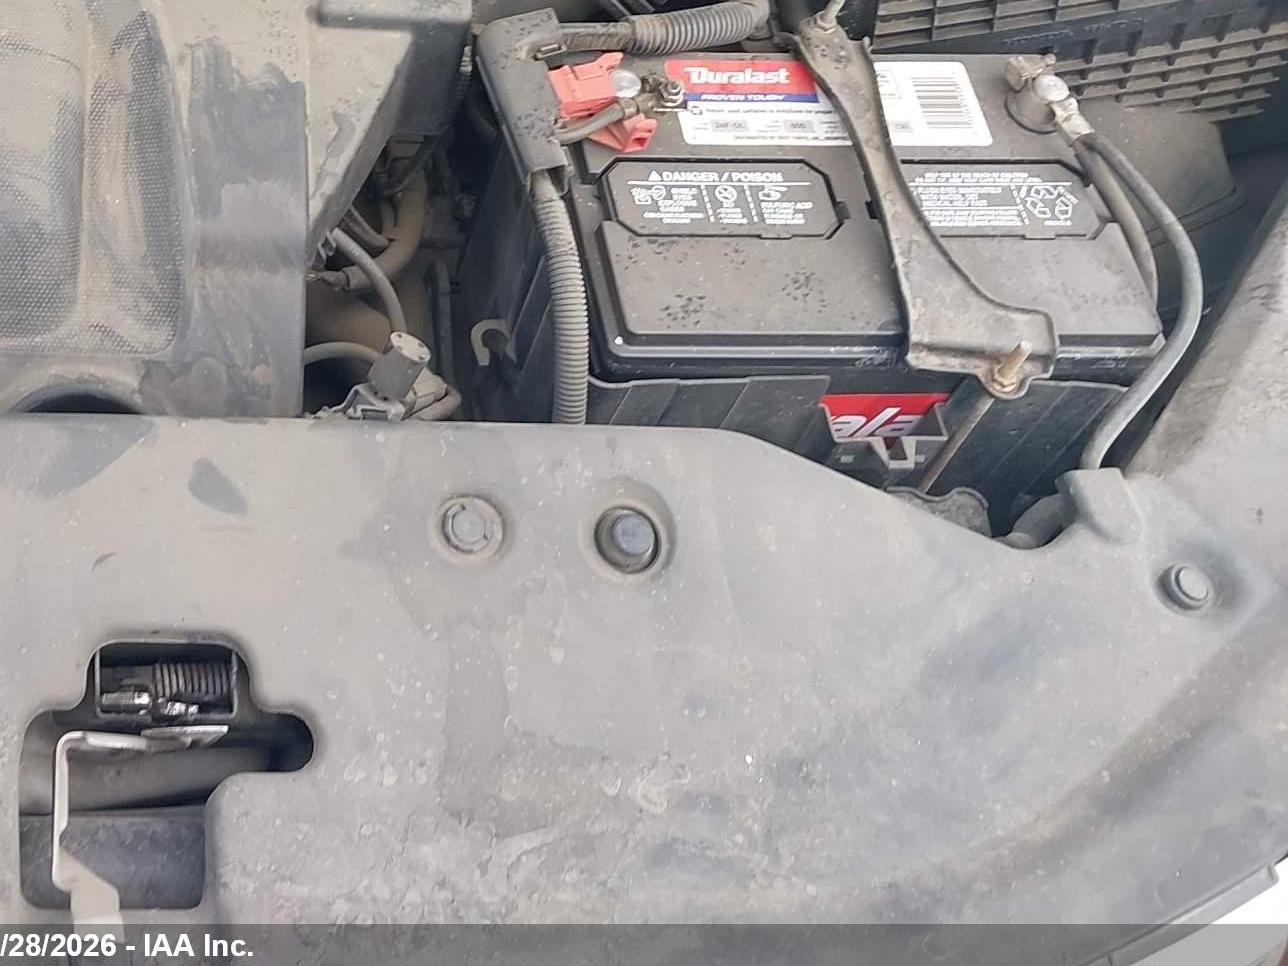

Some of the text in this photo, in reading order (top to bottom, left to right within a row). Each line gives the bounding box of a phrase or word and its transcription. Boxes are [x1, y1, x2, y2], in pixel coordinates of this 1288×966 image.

[684, 66, 791, 85] Duralast
[700, 93, 787, 102] PROVEN TOUGH
[662, 171, 719, 182] DANGER
[731, 172, 784, 182] POISON
